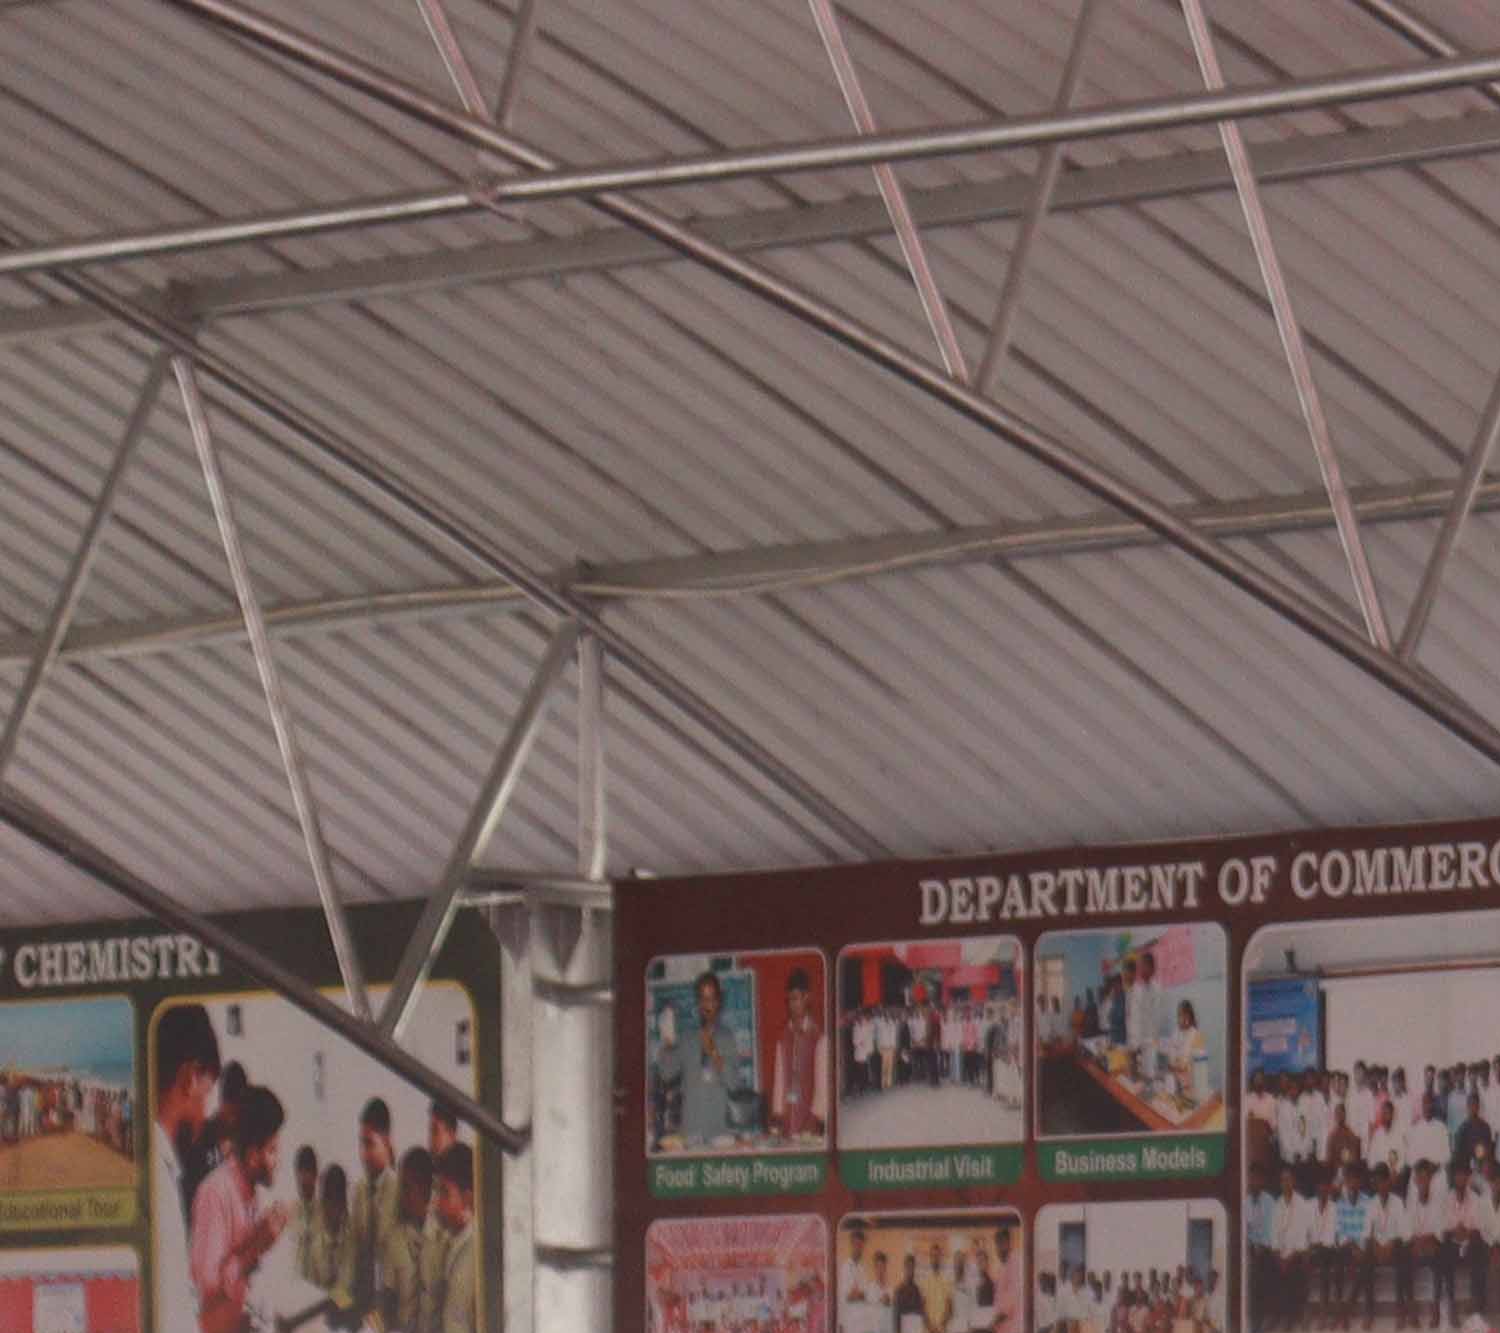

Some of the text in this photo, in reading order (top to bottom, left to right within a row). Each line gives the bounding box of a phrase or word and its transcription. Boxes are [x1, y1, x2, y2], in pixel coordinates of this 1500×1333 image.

[919, 861, 1203, 926] DEPARTMENT
[1217, 856, 1278, 905] OF
[656, 1160, 818, 1189] Food Safety Program
[868, 1155, 994, 1181] Industrial Visit
[1055, 1147, 1206, 1174] Business Models
